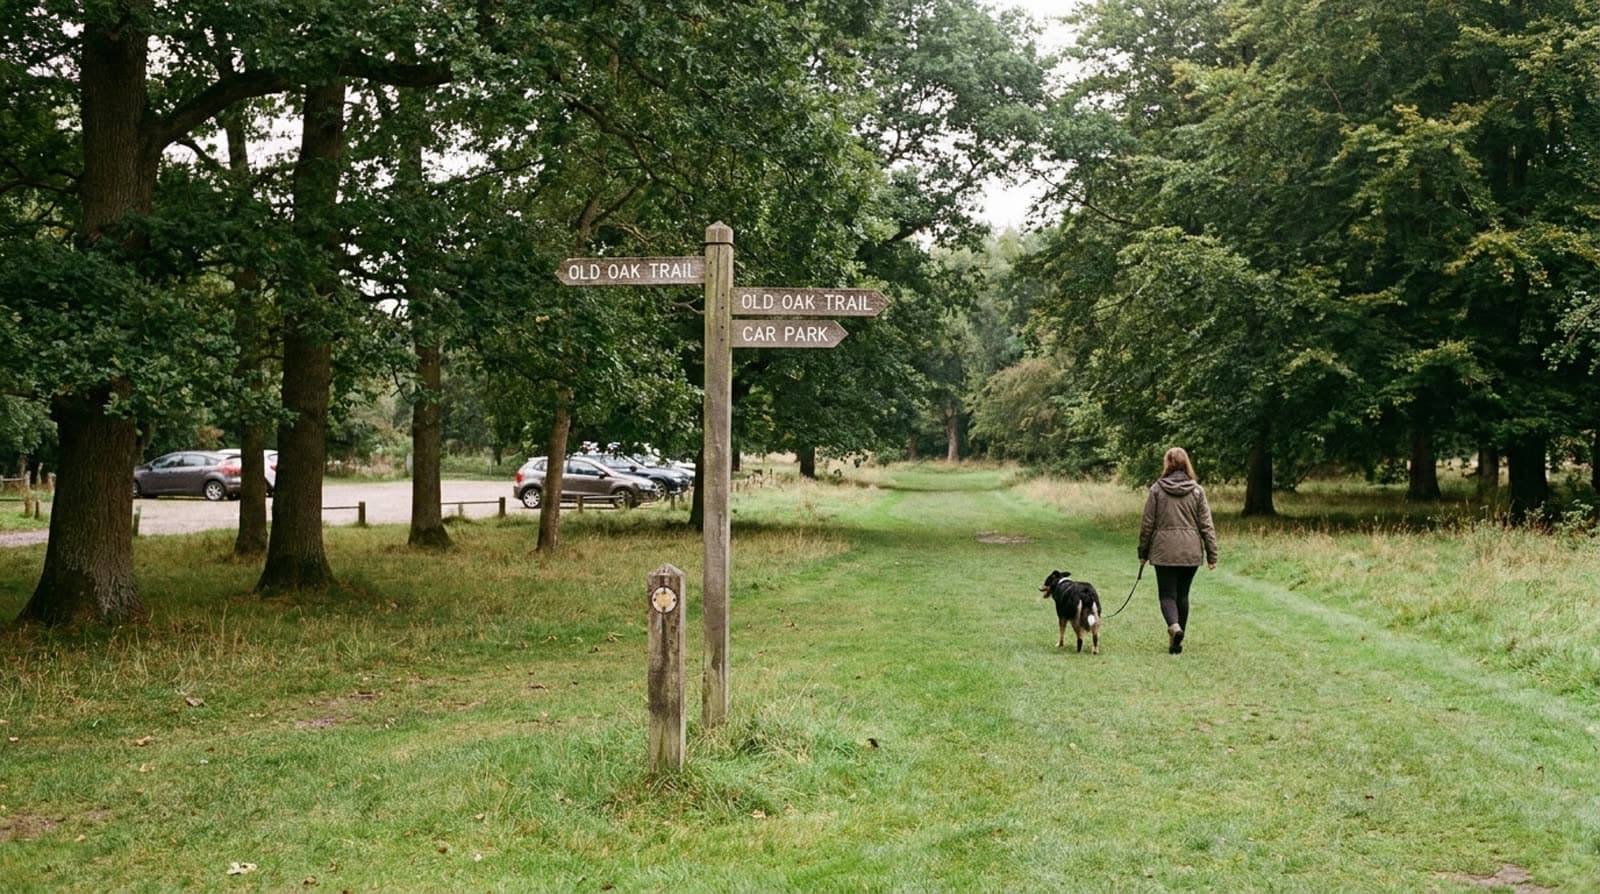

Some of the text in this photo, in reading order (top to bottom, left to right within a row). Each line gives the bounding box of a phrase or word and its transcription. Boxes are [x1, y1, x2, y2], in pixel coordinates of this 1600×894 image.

[568, 263, 696, 280] OLD OAK TRAIL
[742, 294, 873, 311] OLD OAK TRAIL
[742, 326, 829, 342] CAR PARK
